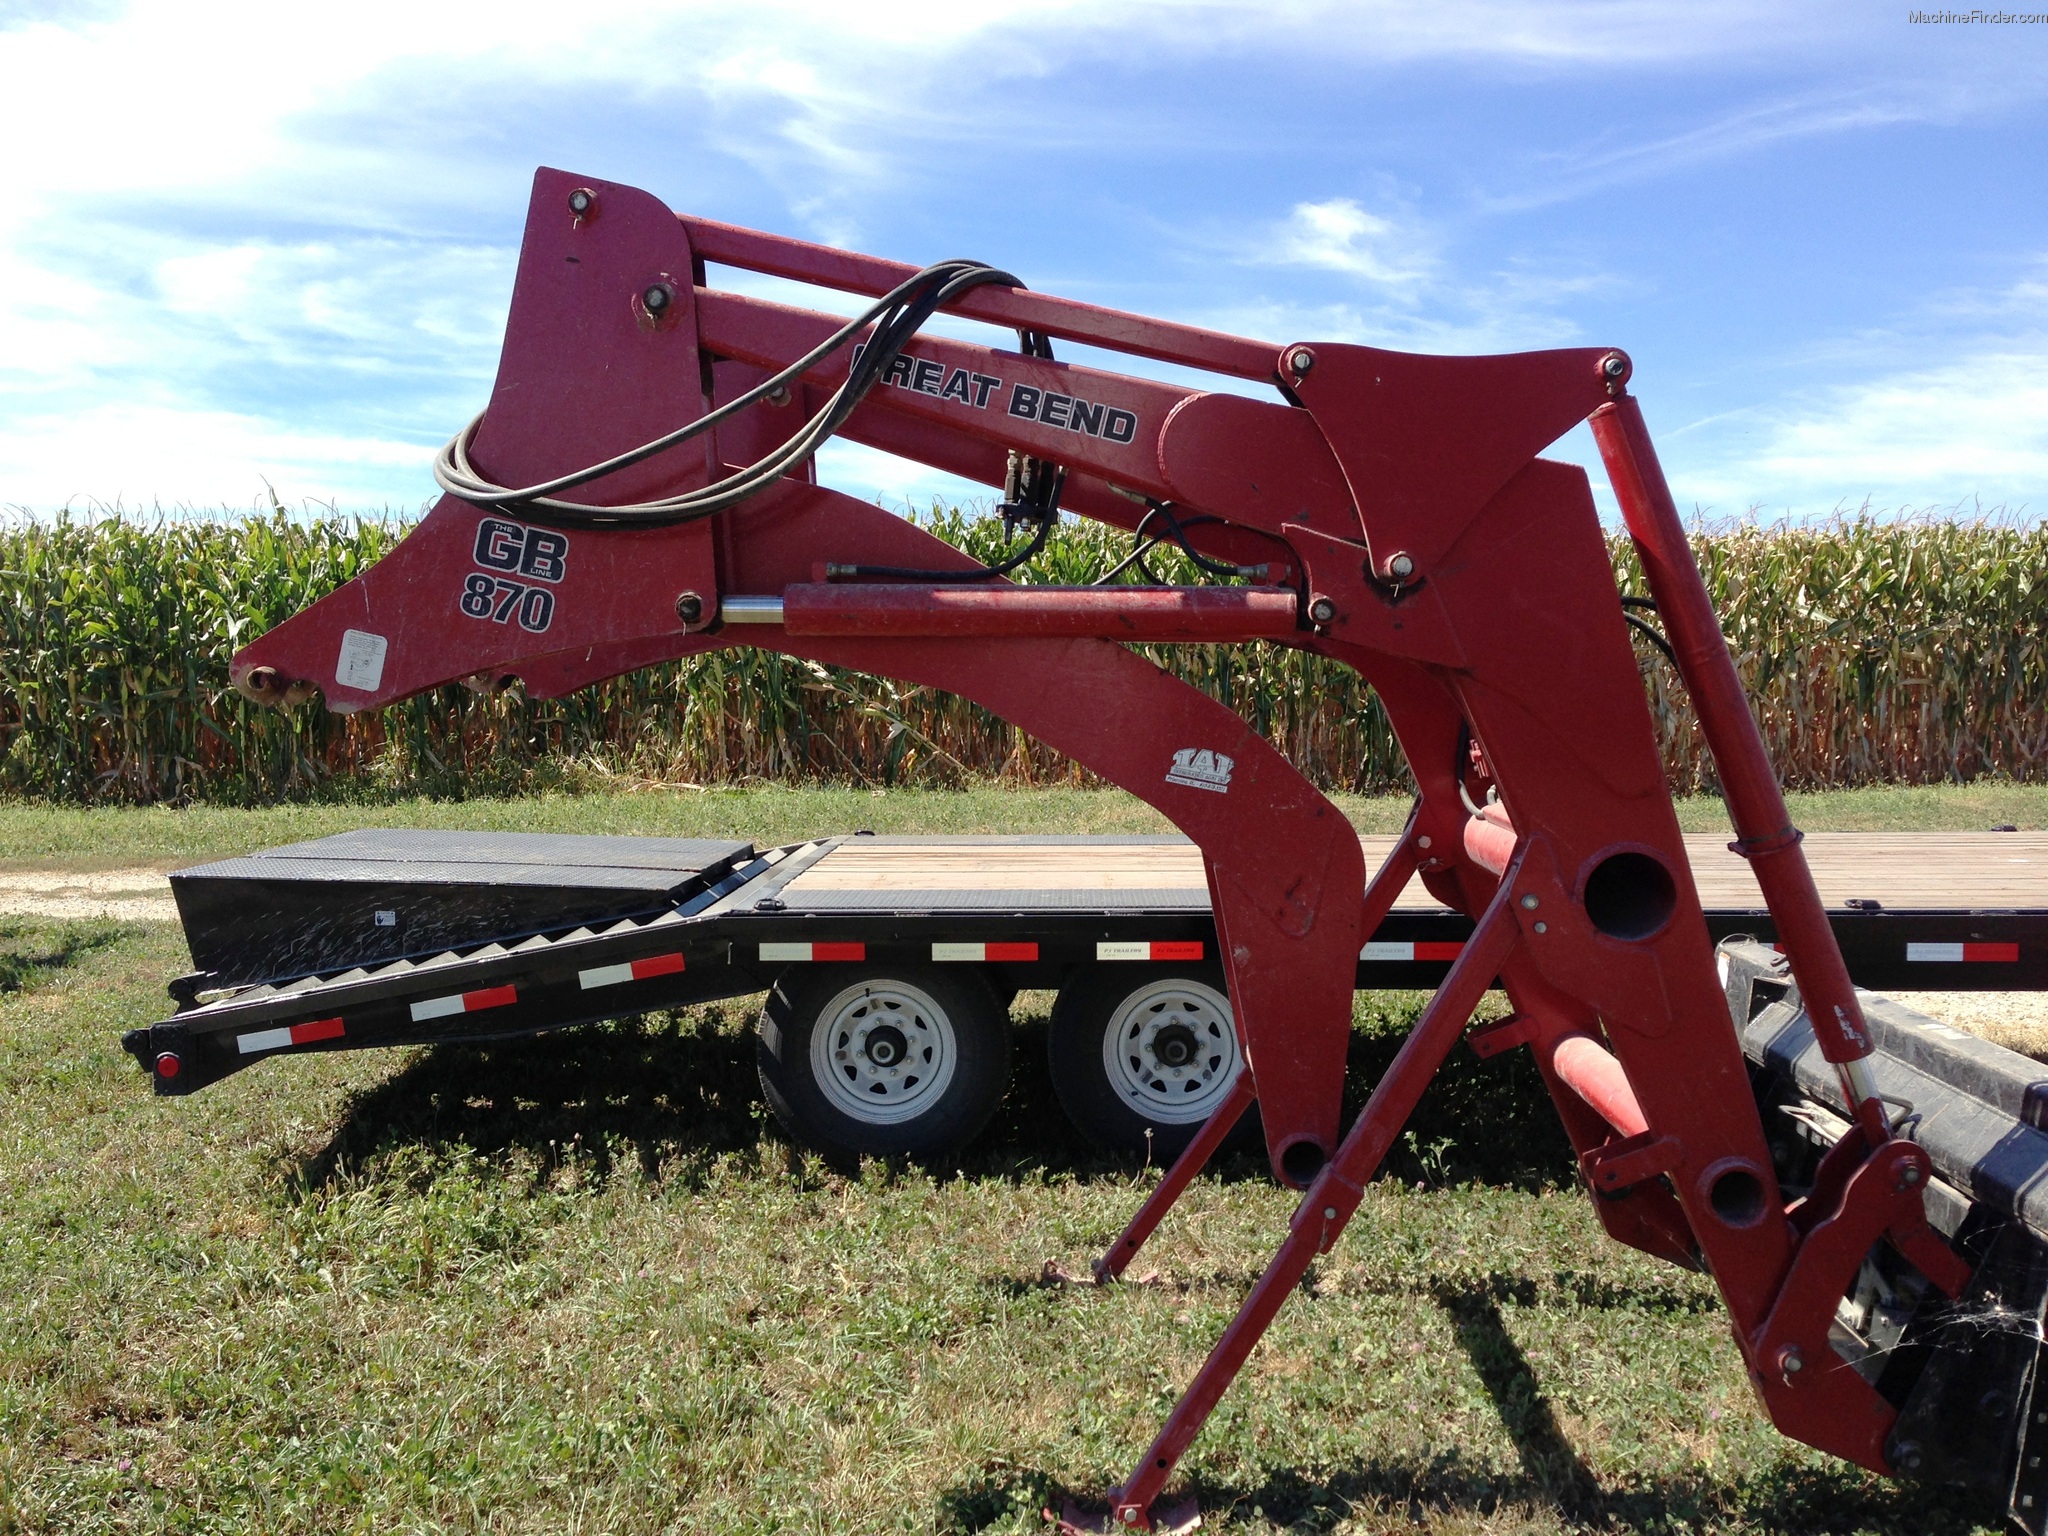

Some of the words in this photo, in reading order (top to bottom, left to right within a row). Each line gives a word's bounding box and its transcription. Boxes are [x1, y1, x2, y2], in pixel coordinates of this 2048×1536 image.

[849, 343, 1002, 409] REAT
[1007, 382, 1138, 445] BEND
[473, 517, 570, 583] GB
[494, 523, 514, 533] THE
[459, 572, 556, 633] 870
[530, 567, 552, 578] LINE
